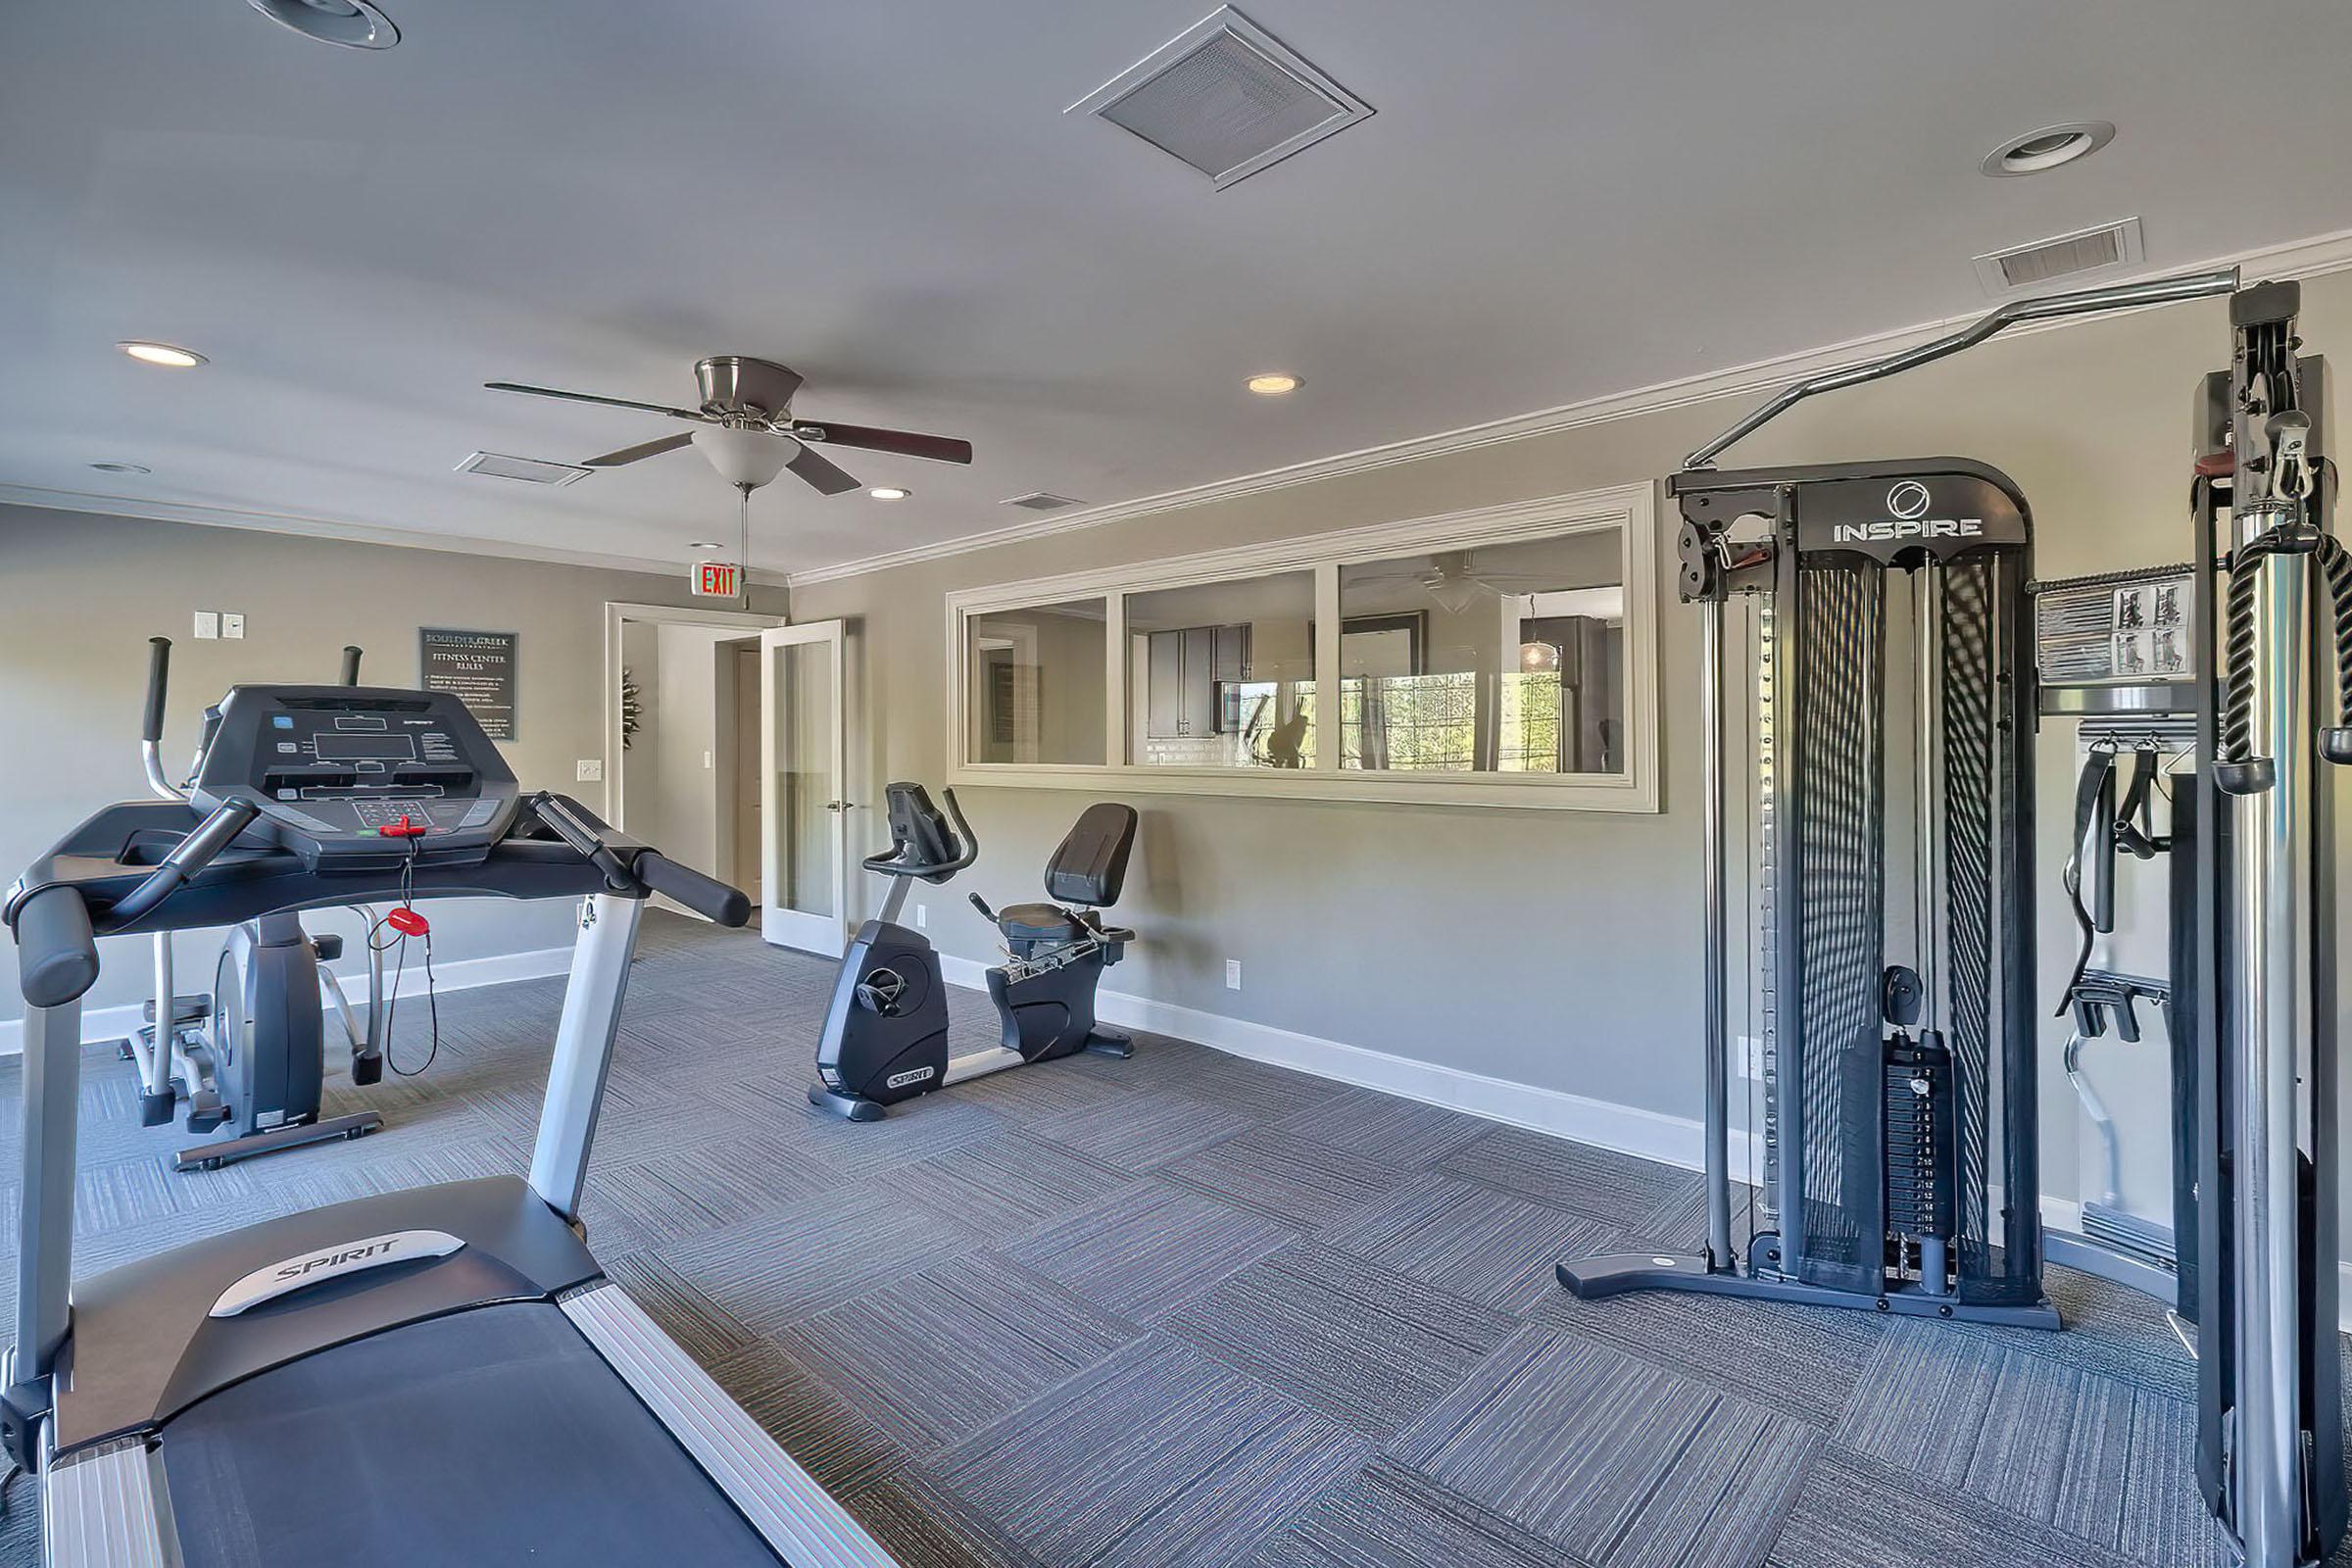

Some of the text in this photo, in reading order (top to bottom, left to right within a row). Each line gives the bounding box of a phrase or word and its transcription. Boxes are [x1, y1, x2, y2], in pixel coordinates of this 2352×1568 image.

[1834, 518, 1983, 543] INSPIRE
[702, 566, 735, 595] EXIT
[432, 653, 507, 663] FITNESS CENTER
[456, 662, 484, 670] RULES
[890, 1069, 928, 1086] SPIRIT
[275, 1239, 400, 1282] SPIRIT
